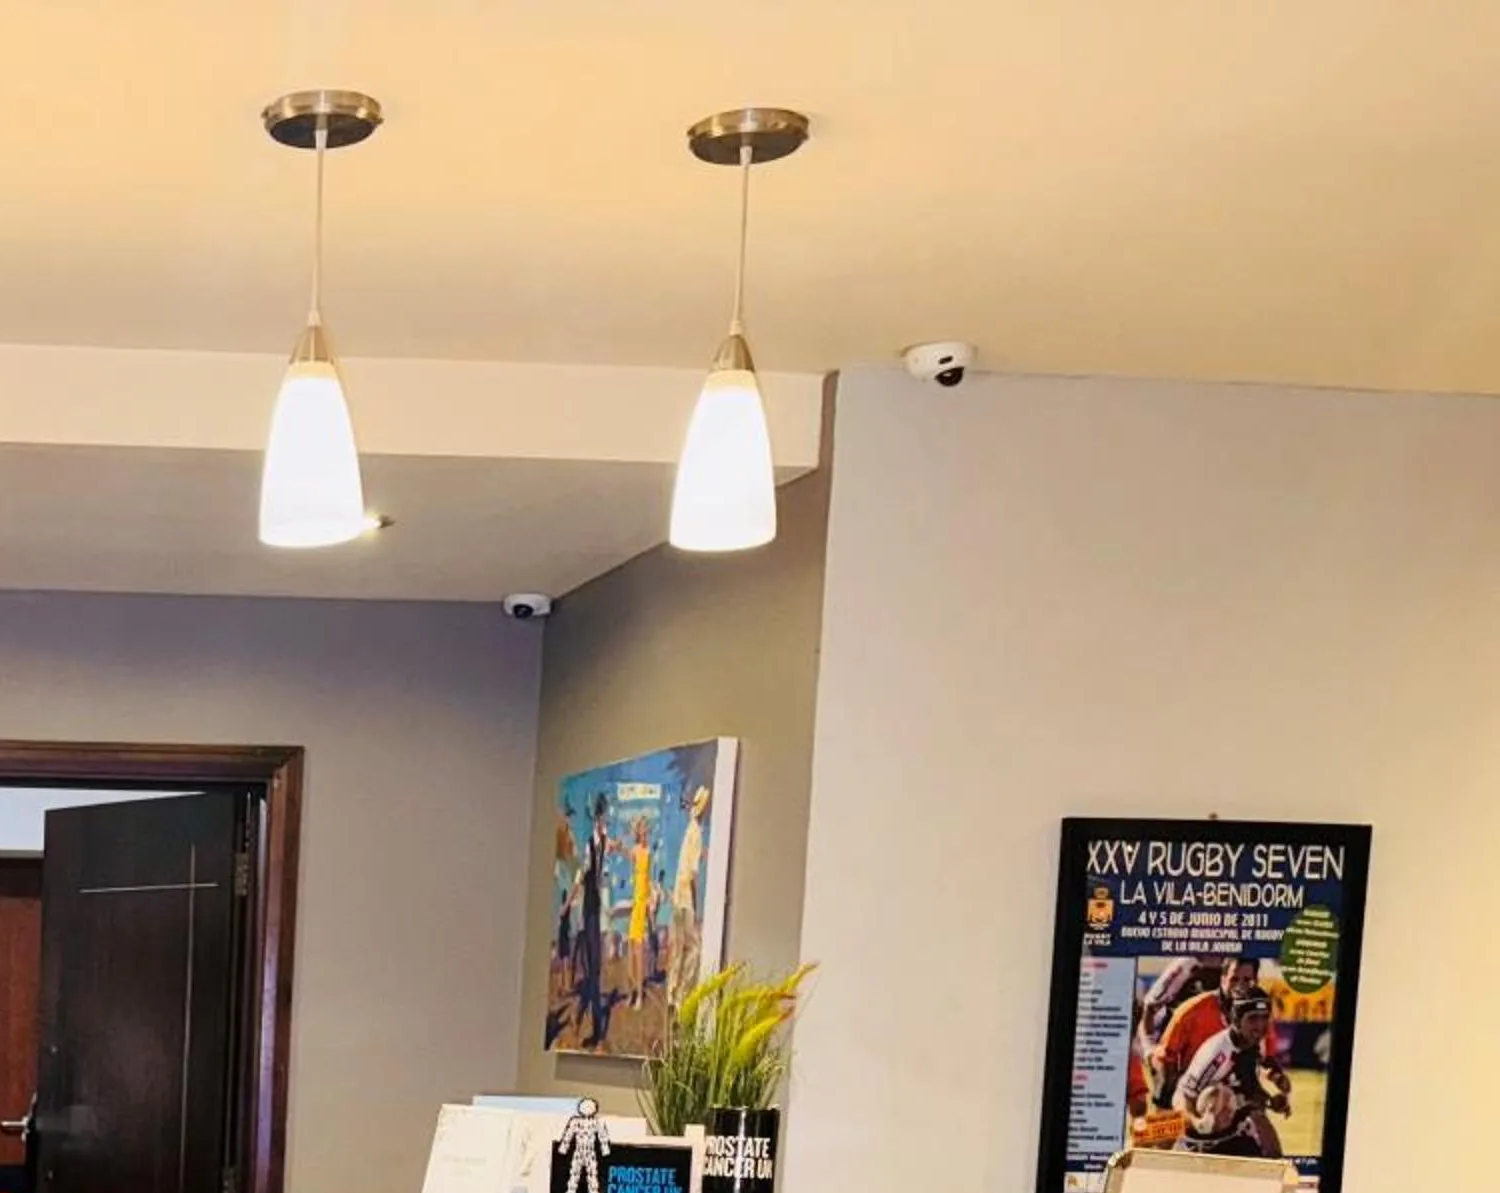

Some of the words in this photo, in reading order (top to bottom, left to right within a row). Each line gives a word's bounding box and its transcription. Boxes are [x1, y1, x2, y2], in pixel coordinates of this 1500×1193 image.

[1086, 839, 1140, 876] XXV
[1148, 841, 1245, 878] RUGBY
[1251, 844, 1346, 880] SEVEN
[1120, 880, 1148, 905] LA
[1153, 881, 1304, 908] VILA-BENIDORM
[1138, 911, 1147, 925] 4
[1150, 911, 1158, 925] Y
[1160, 912, 1168, 925] 5
[1169, 912, 1184, 926] DE
[1187, 912, 1221, 927] JUNIO
[1223, 913, 1238, 927] DE
[1241, 914, 1269, 928] 2011
[608, 1165, 677, 1186] PROSTATE
